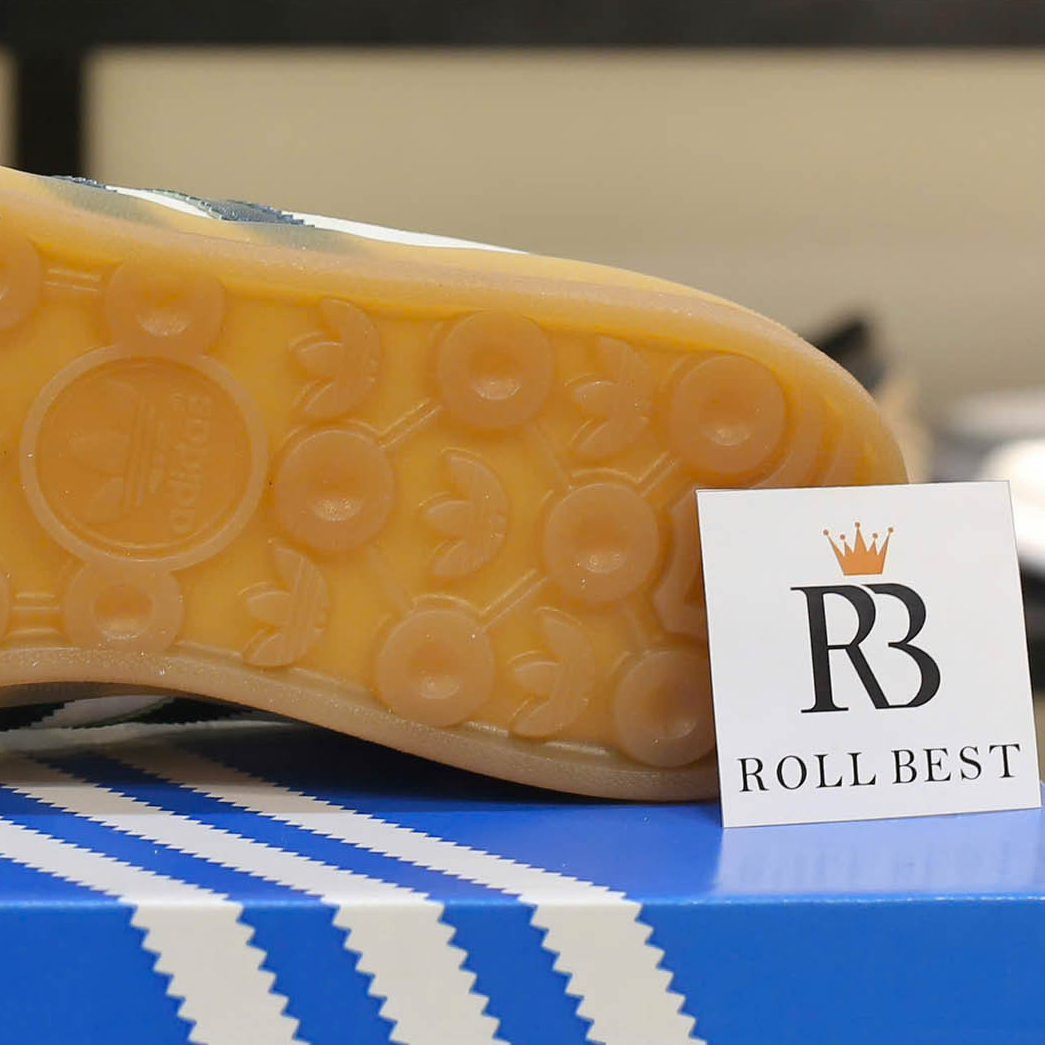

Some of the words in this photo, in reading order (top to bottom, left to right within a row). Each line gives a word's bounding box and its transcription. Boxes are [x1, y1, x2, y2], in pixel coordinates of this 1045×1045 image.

[790, 582, 941, 714] RB
[737, 752, 877, 793] ROLL
[891, 743, 1021, 785] BEST
